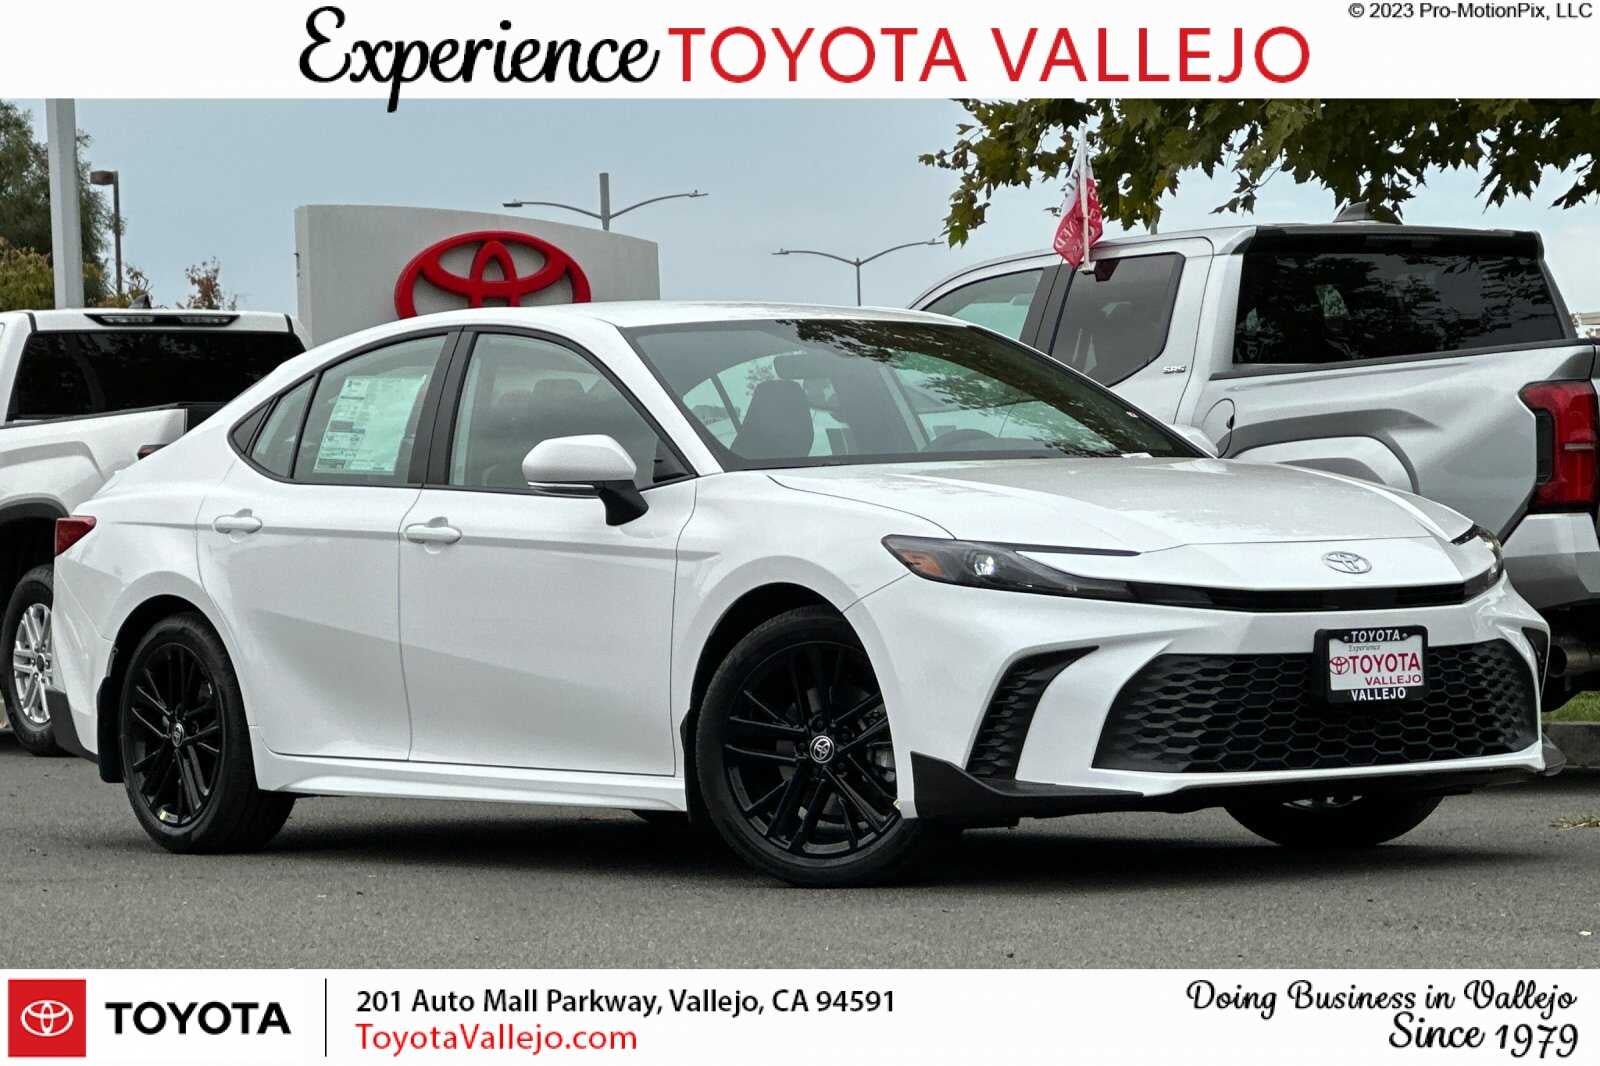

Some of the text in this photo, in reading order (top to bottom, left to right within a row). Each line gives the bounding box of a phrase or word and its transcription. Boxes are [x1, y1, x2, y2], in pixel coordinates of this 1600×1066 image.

[1351, 629, 1400, 642] TOYOTA
[1349, 653, 1421, 674] TOYOTA
[1365, 674, 1422, 686] VALLEJO
[1351, 688, 1406, 701] VALLEJO
